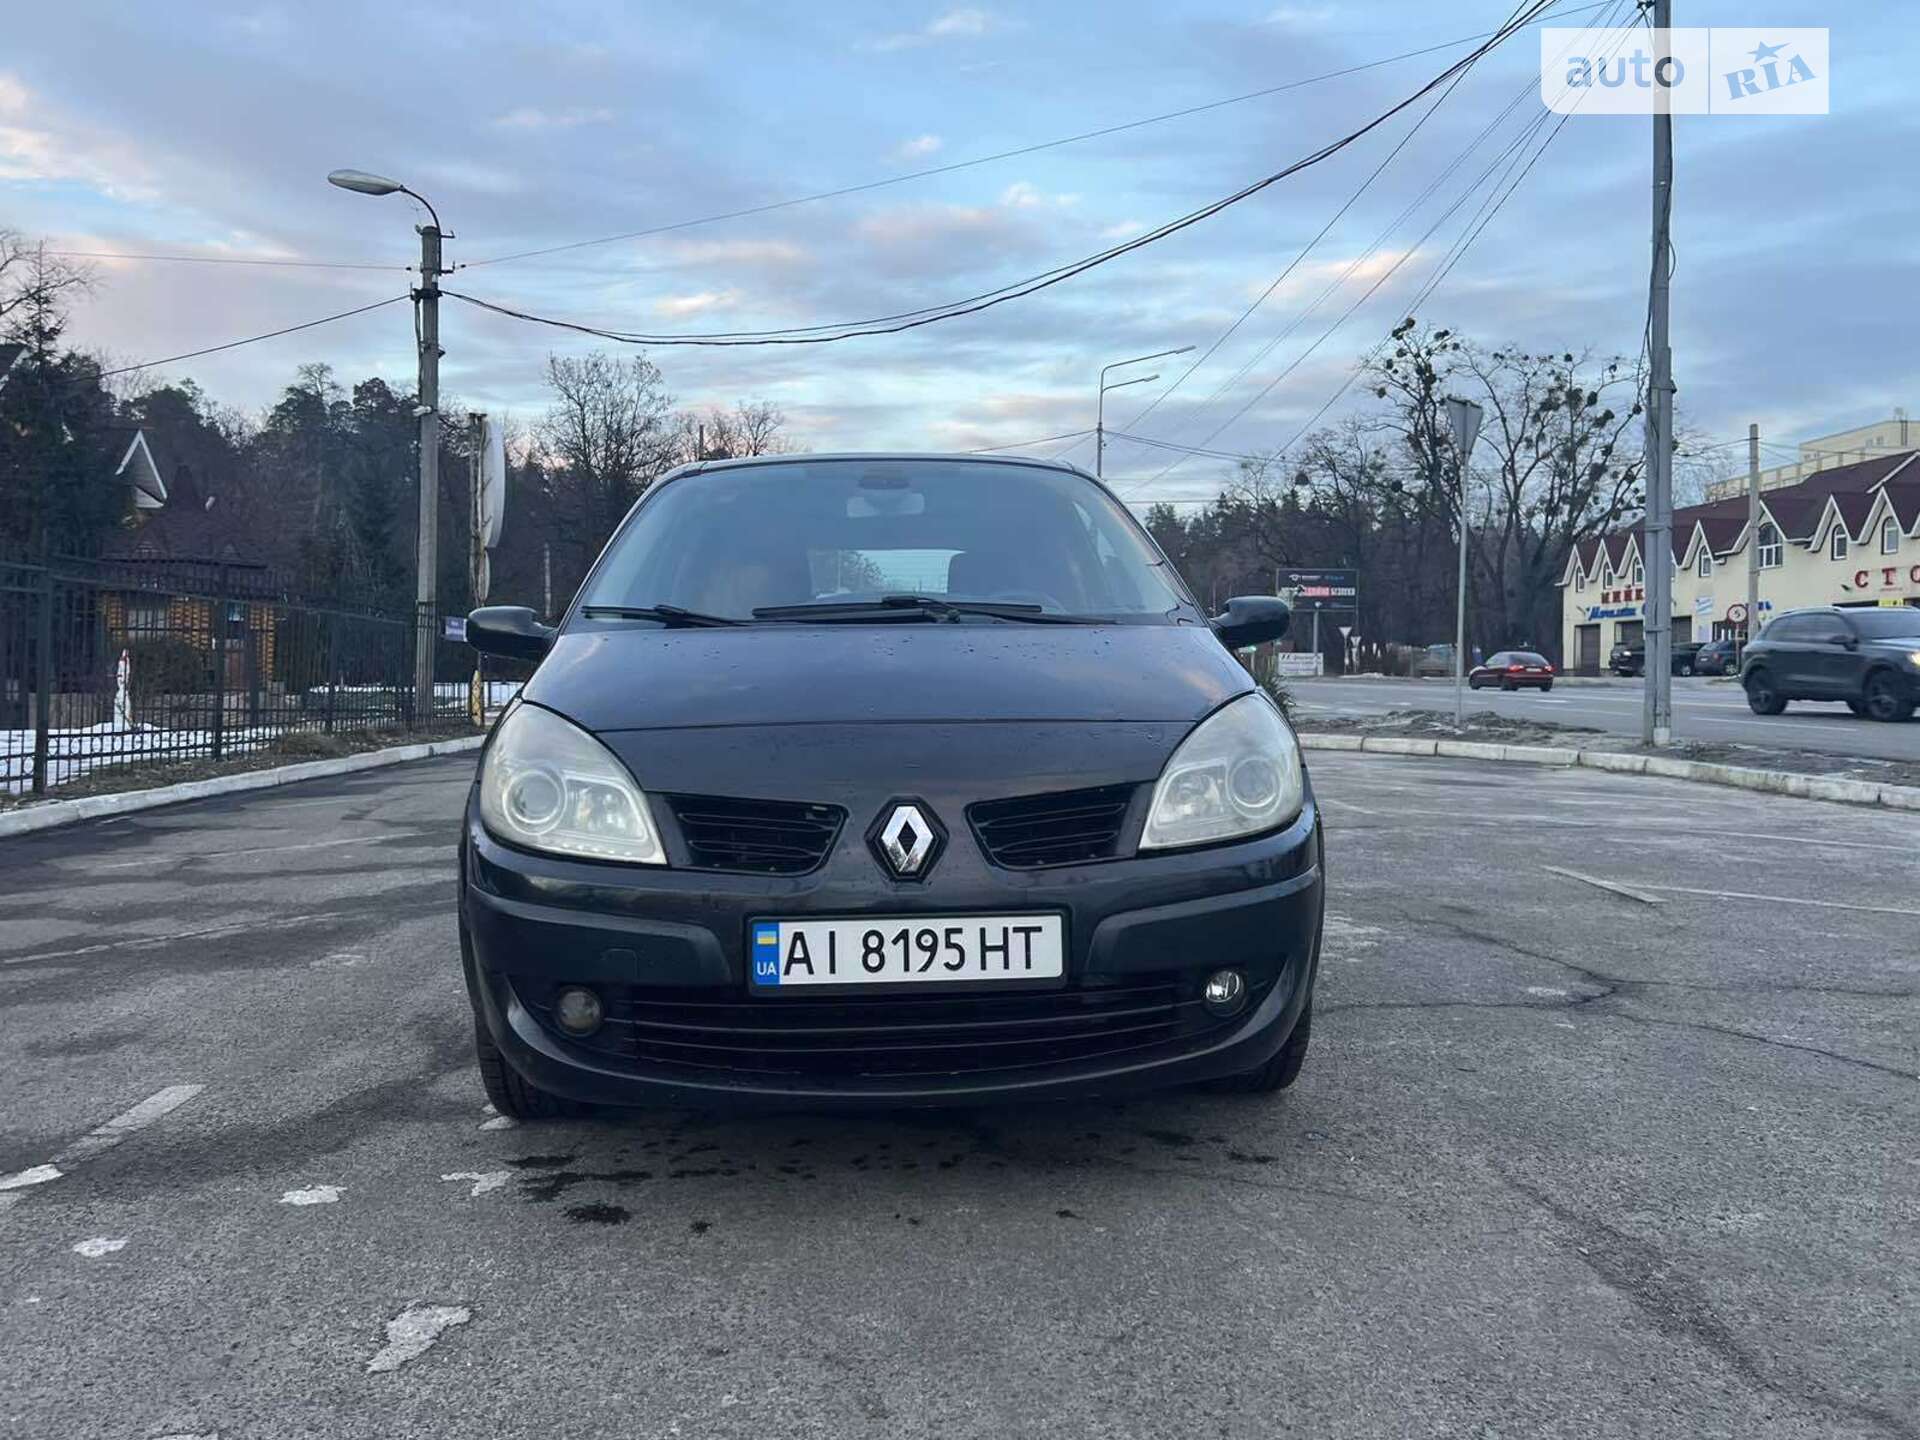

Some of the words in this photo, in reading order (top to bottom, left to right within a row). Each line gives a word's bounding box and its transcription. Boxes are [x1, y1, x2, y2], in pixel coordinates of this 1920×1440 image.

[783, 930, 837, 976] AI
[862, 927, 966, 974] 8195
[980, 926, 1042, 971] HT
[757, 961, 777, 976] UA
